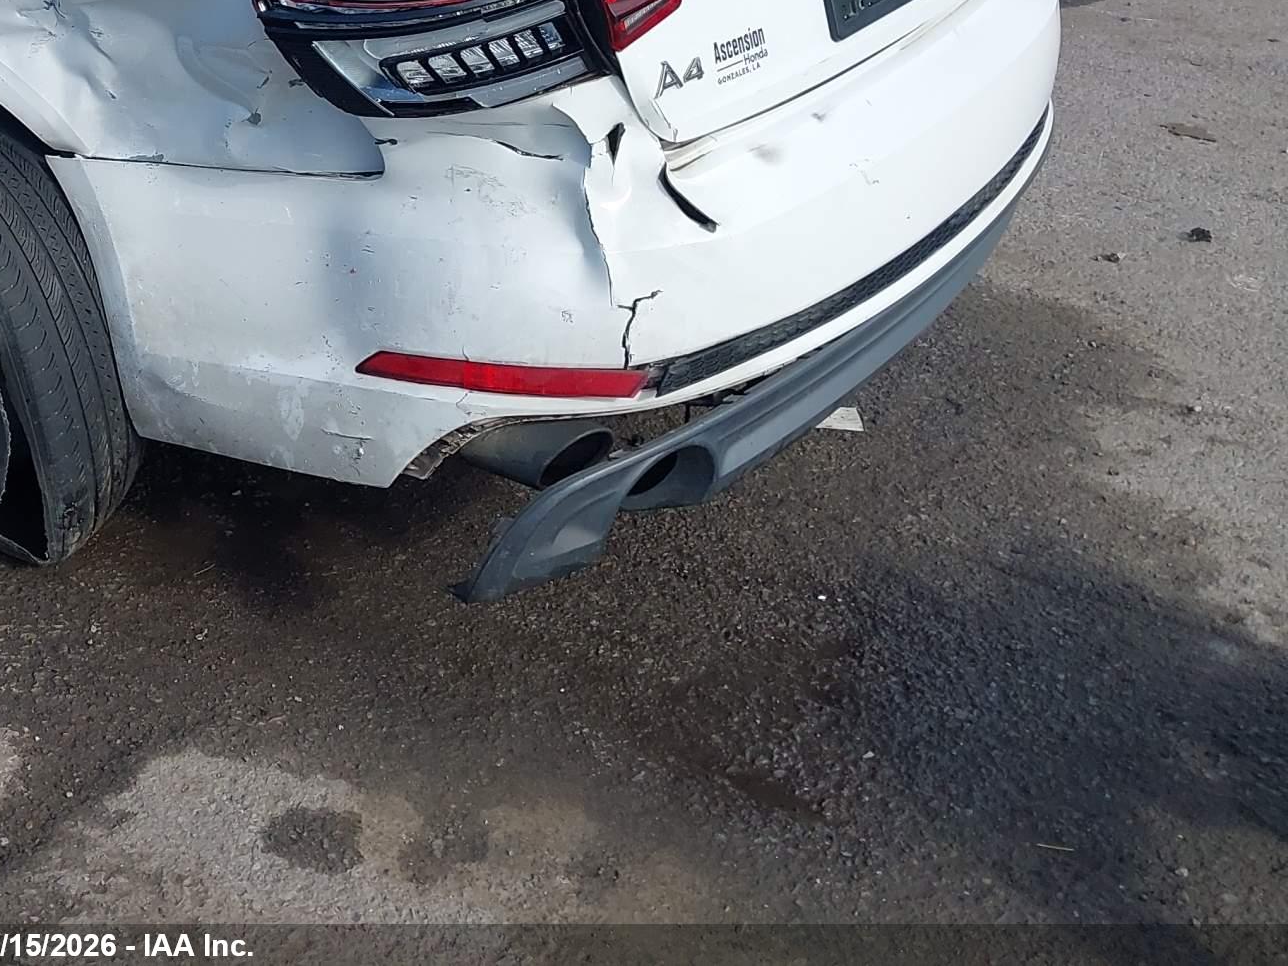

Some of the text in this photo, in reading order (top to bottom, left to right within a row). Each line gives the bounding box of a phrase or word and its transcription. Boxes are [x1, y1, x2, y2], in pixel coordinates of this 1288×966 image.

[713, 27, 766, 64] Ascension
[743, 46, 769, 66] Honda
[653, 56, 705, 100] A4
[752, 62, 761, 73] LA
